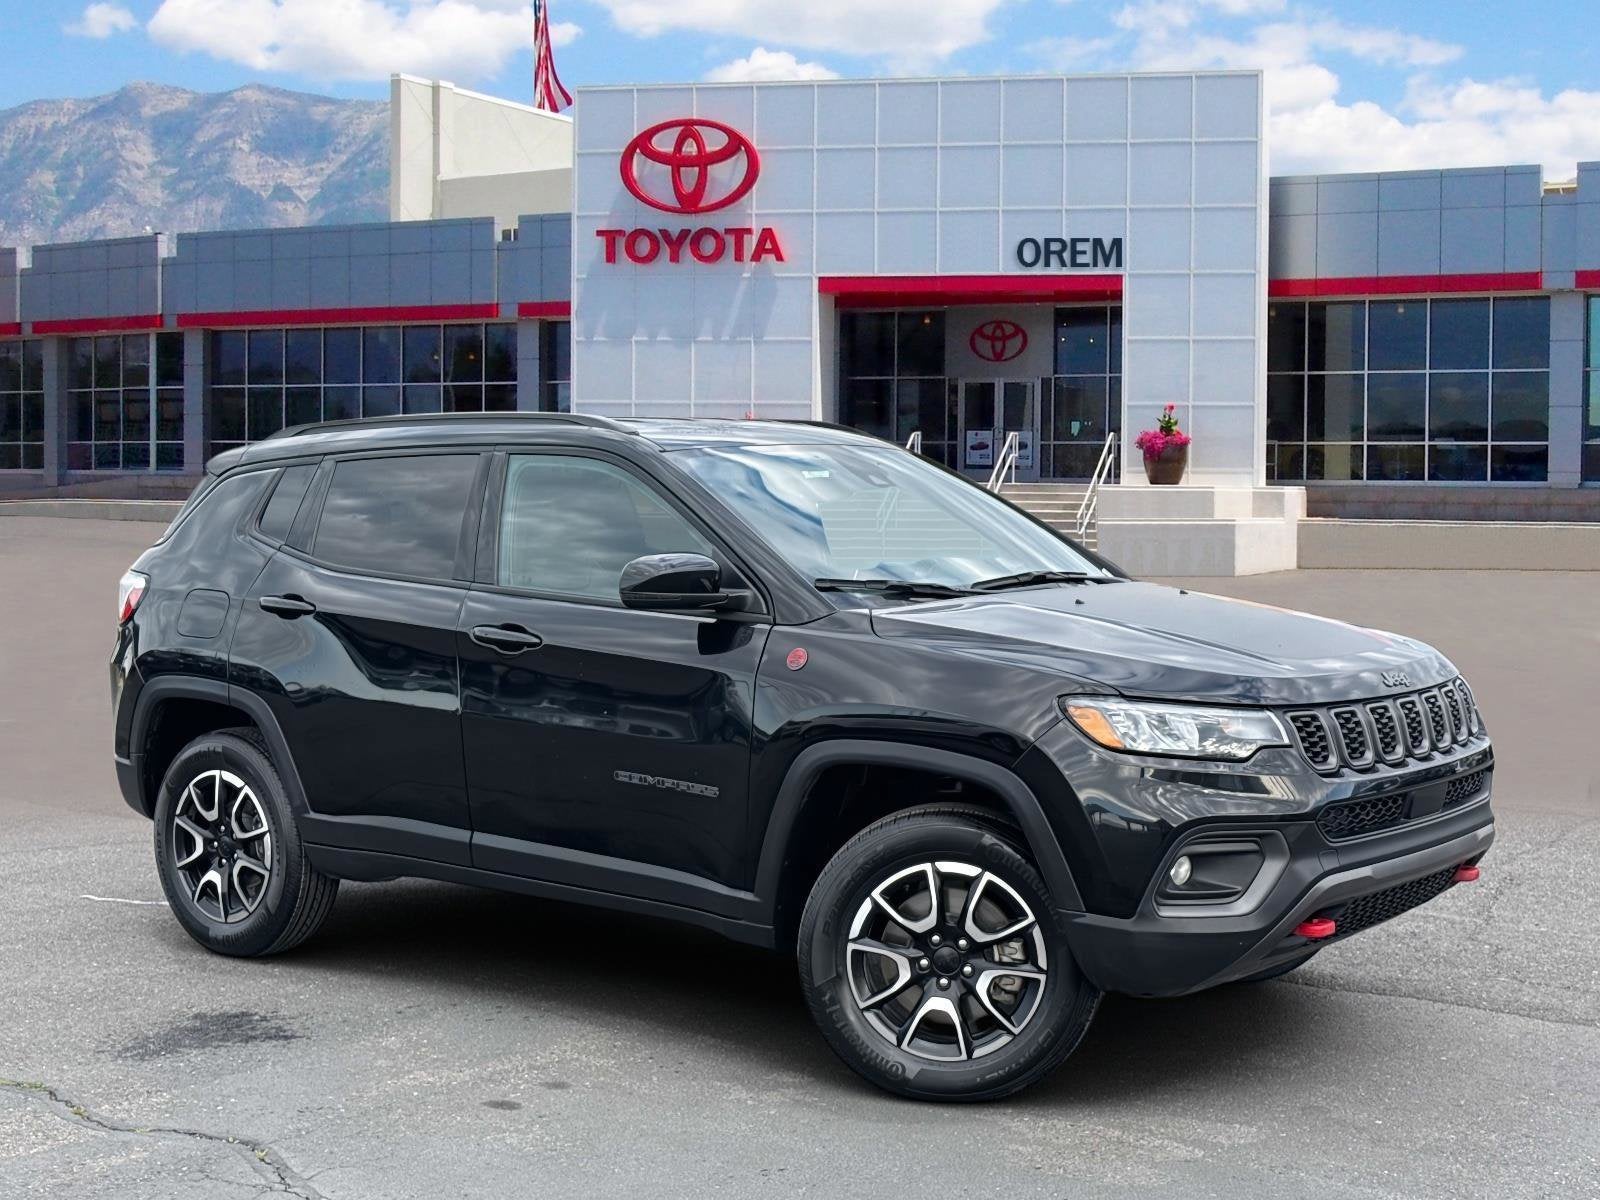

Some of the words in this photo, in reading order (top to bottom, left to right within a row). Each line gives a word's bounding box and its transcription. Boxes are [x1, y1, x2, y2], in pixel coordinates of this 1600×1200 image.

[596, 227, 785, 264] TOYOTA
[1016, 237, 1123, 269] OREM
[1380, 671, 1411, 688] Jeep
[614, 770, 720, 798] COMPASS
